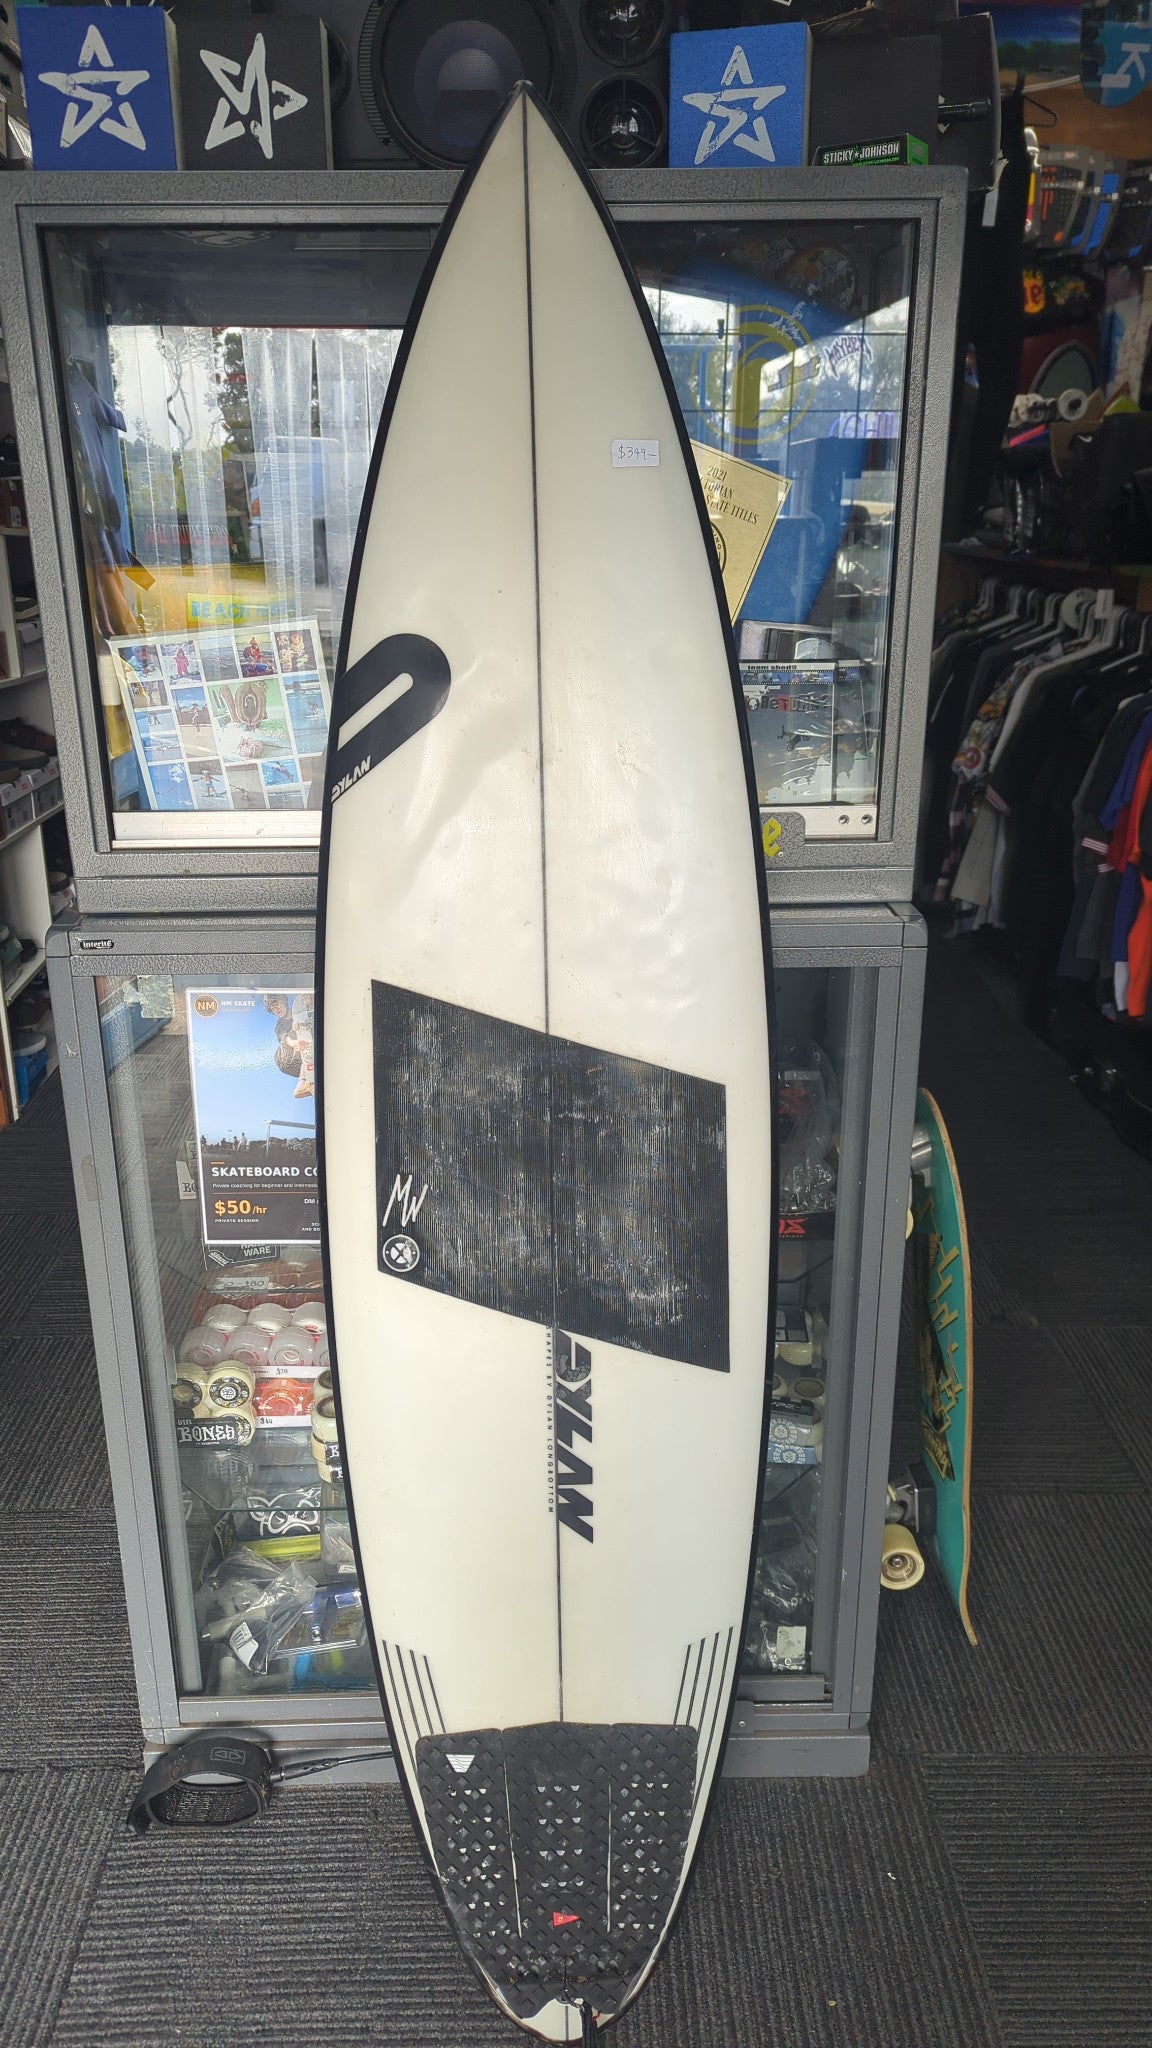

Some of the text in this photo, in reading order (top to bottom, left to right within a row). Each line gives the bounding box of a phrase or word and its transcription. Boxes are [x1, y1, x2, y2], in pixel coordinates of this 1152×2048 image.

[823, 142, 900, 164] STICKY JOHNSON
[706, 465, 727, 481] 2021
[706, 494, 760, 525] STATE TITLES
[331, 754, 372, 804] DYLAN
[197, 1001, 215, 1011] NM
[211, 1167, 300, 1177] SKATEBOARD
[214, 1199, 268, 1217] $50 /hr
[243, 1245, 272, 1257] WARE
[177, 1425, 235, 1443] BONES
[555, 1328, 594, 1544] DYLAN
